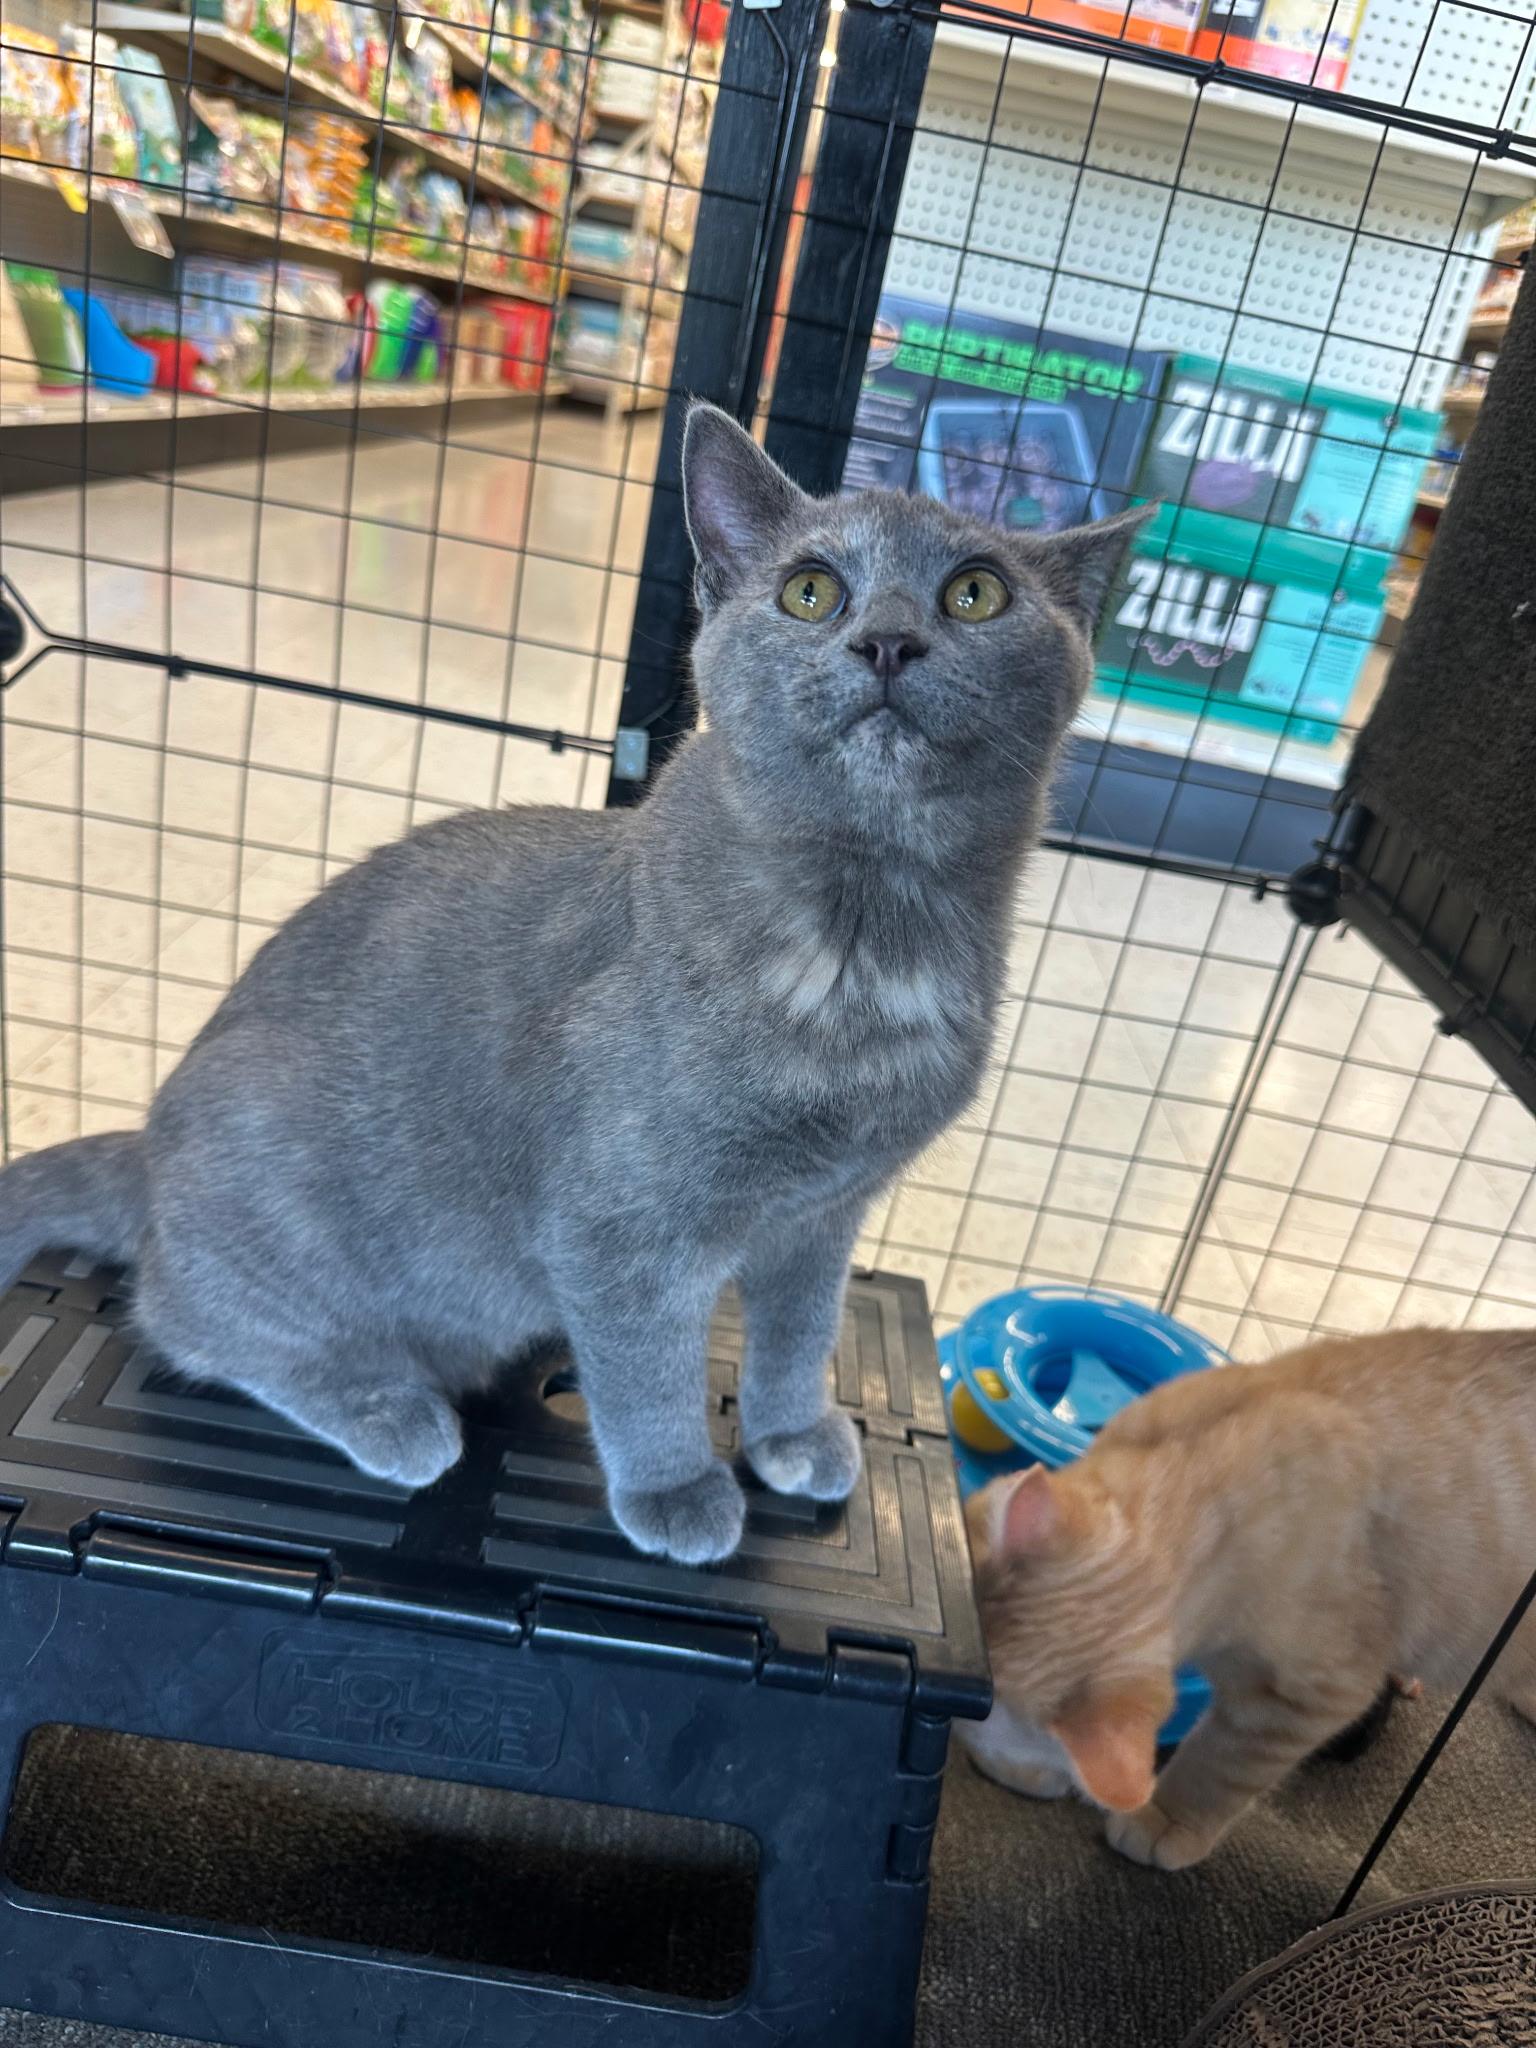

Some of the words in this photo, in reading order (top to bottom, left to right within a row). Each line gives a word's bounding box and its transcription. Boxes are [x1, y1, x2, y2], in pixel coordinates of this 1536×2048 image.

[1158, 380, 1318, 483] ZILLA
[1115, 559, 1270, 653] ZILLA
[288, 1704, 321, 1736] 2
[335, 1702, 530, 1765] HOME
[292, 1658, 537, 1731] HOUSE
